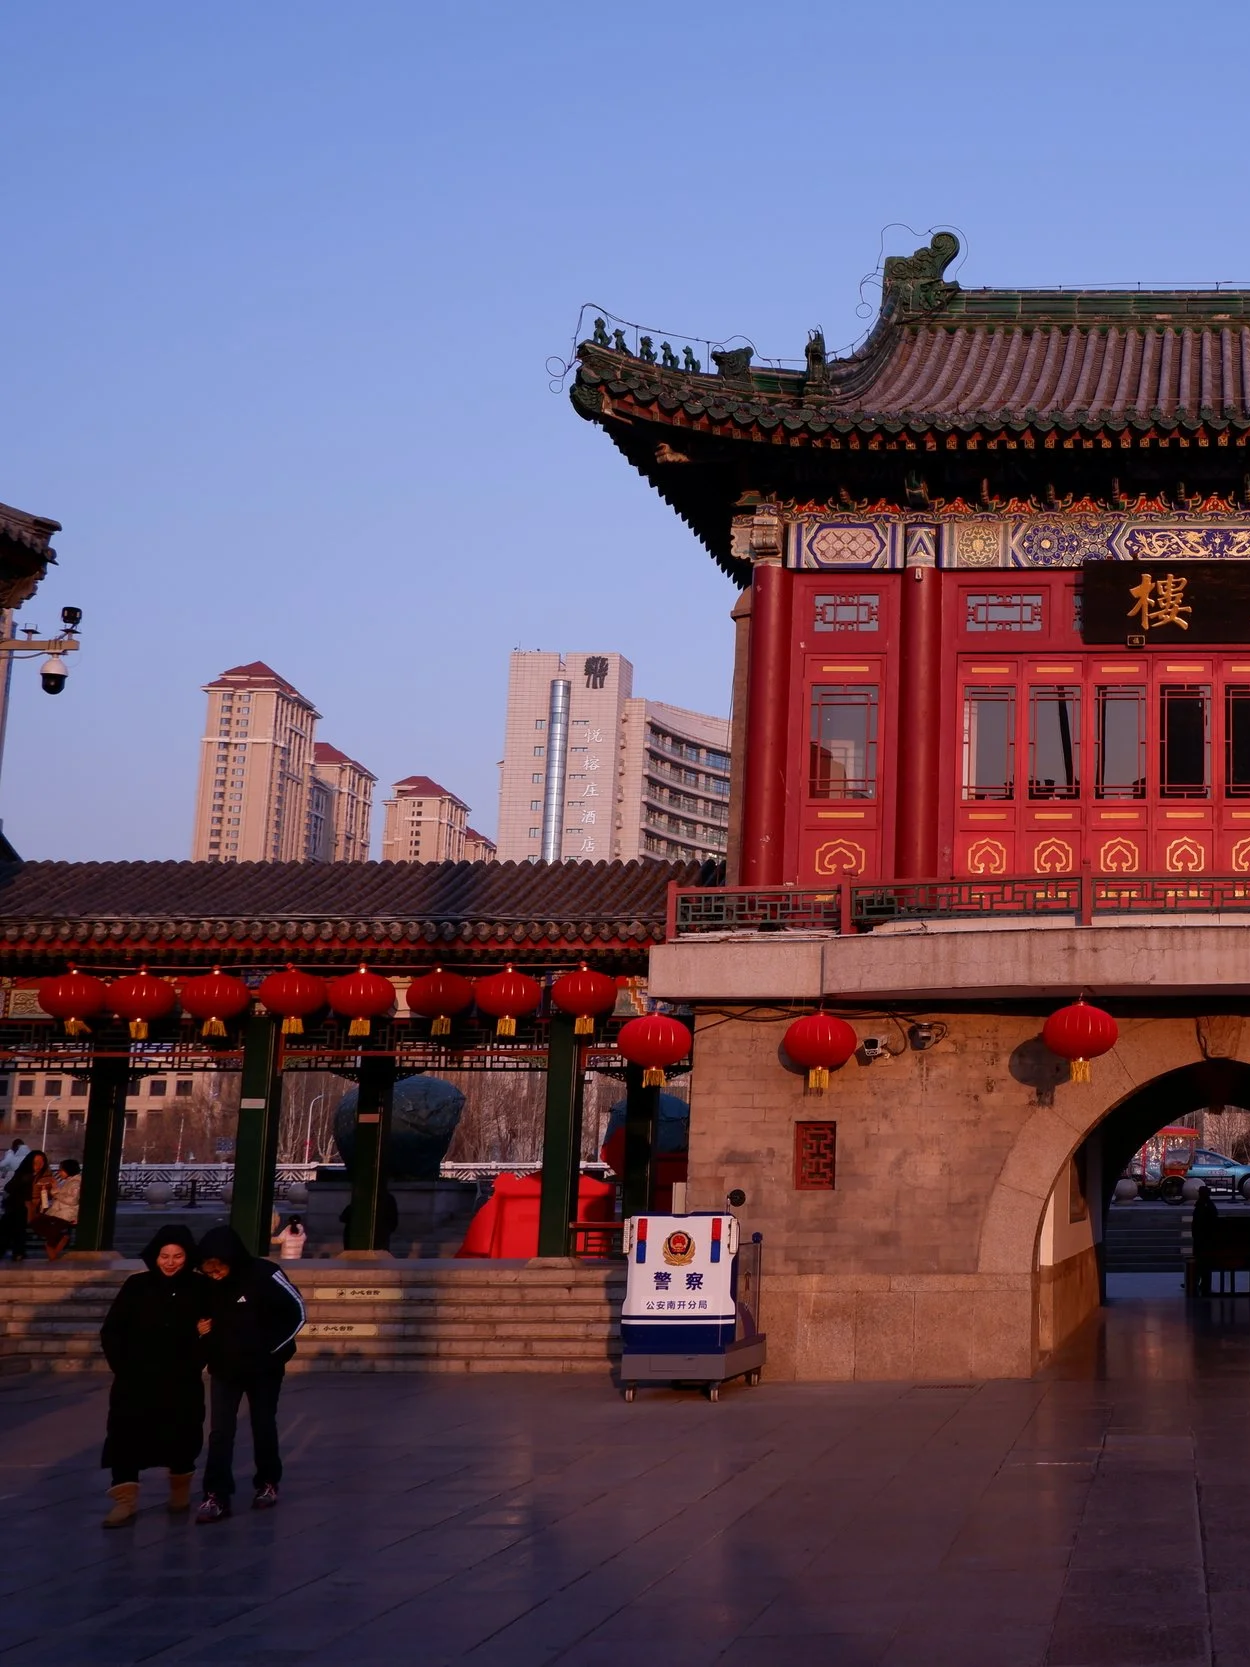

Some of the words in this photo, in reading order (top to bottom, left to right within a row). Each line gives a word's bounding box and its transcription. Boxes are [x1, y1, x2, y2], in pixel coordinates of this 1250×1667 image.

[579, 728, 603, 853] 悦榕庄酒店
[653, 1271, 704, 1291] 警察
[645, 1300, 708, 1310] 公安南开分局
